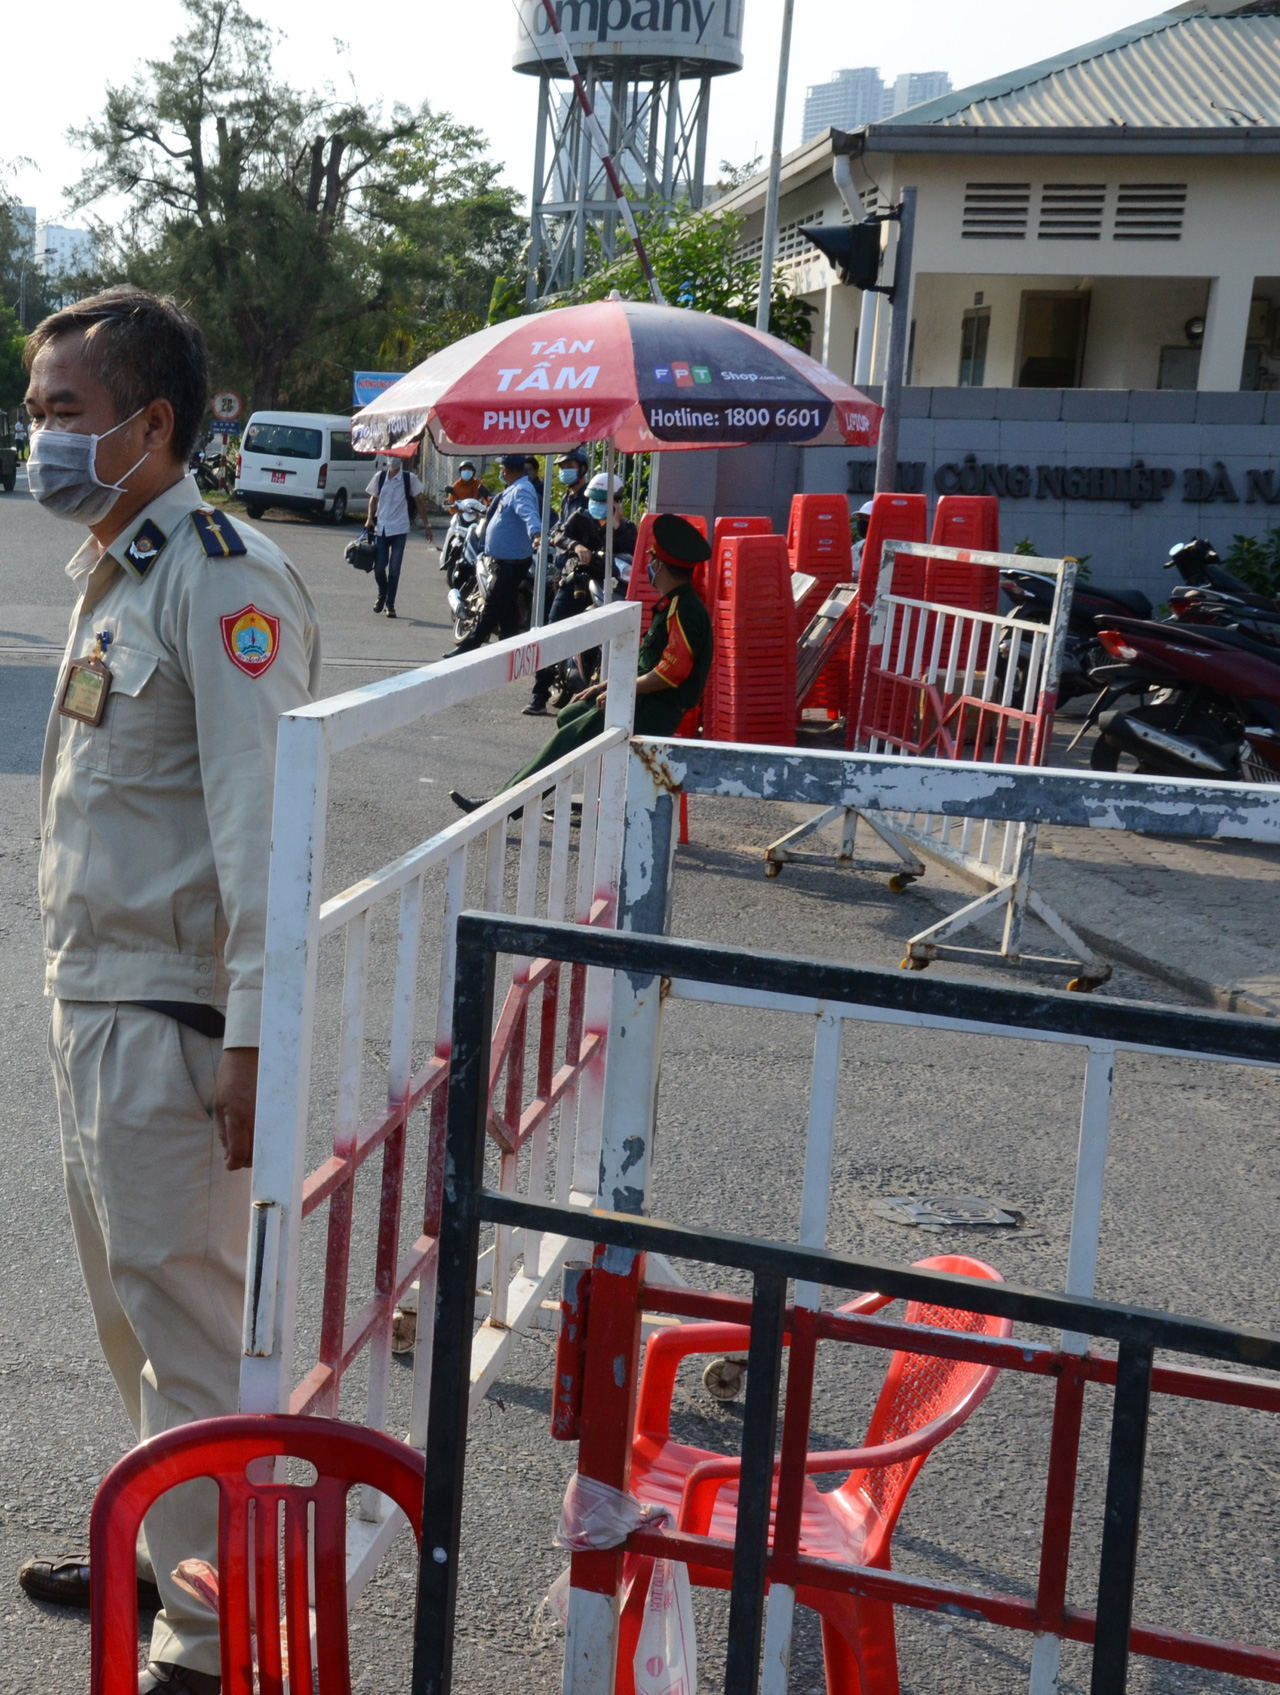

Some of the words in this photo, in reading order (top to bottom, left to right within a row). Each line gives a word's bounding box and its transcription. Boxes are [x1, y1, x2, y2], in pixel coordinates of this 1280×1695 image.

[531, 337, 595, 359] TẬN
[497, 361, 601, 392] TÂM
[654, 364, 710, 384] FPT
[483, 409, 551, 434] PHỤC
[558, 407, 591, 433] VỤ
[650, 407, 720, 427] Hotline:
[724, 407, 770, 427] 1800
[775, 408, 820, 427] 6601
[847, 460, 927, 494] KU
[933, 453, 1033, 498] CÔNG
[1036, 459, 1176, 509] NGHIỆP
[1181, 460, 1240, 503] ĐÀ
